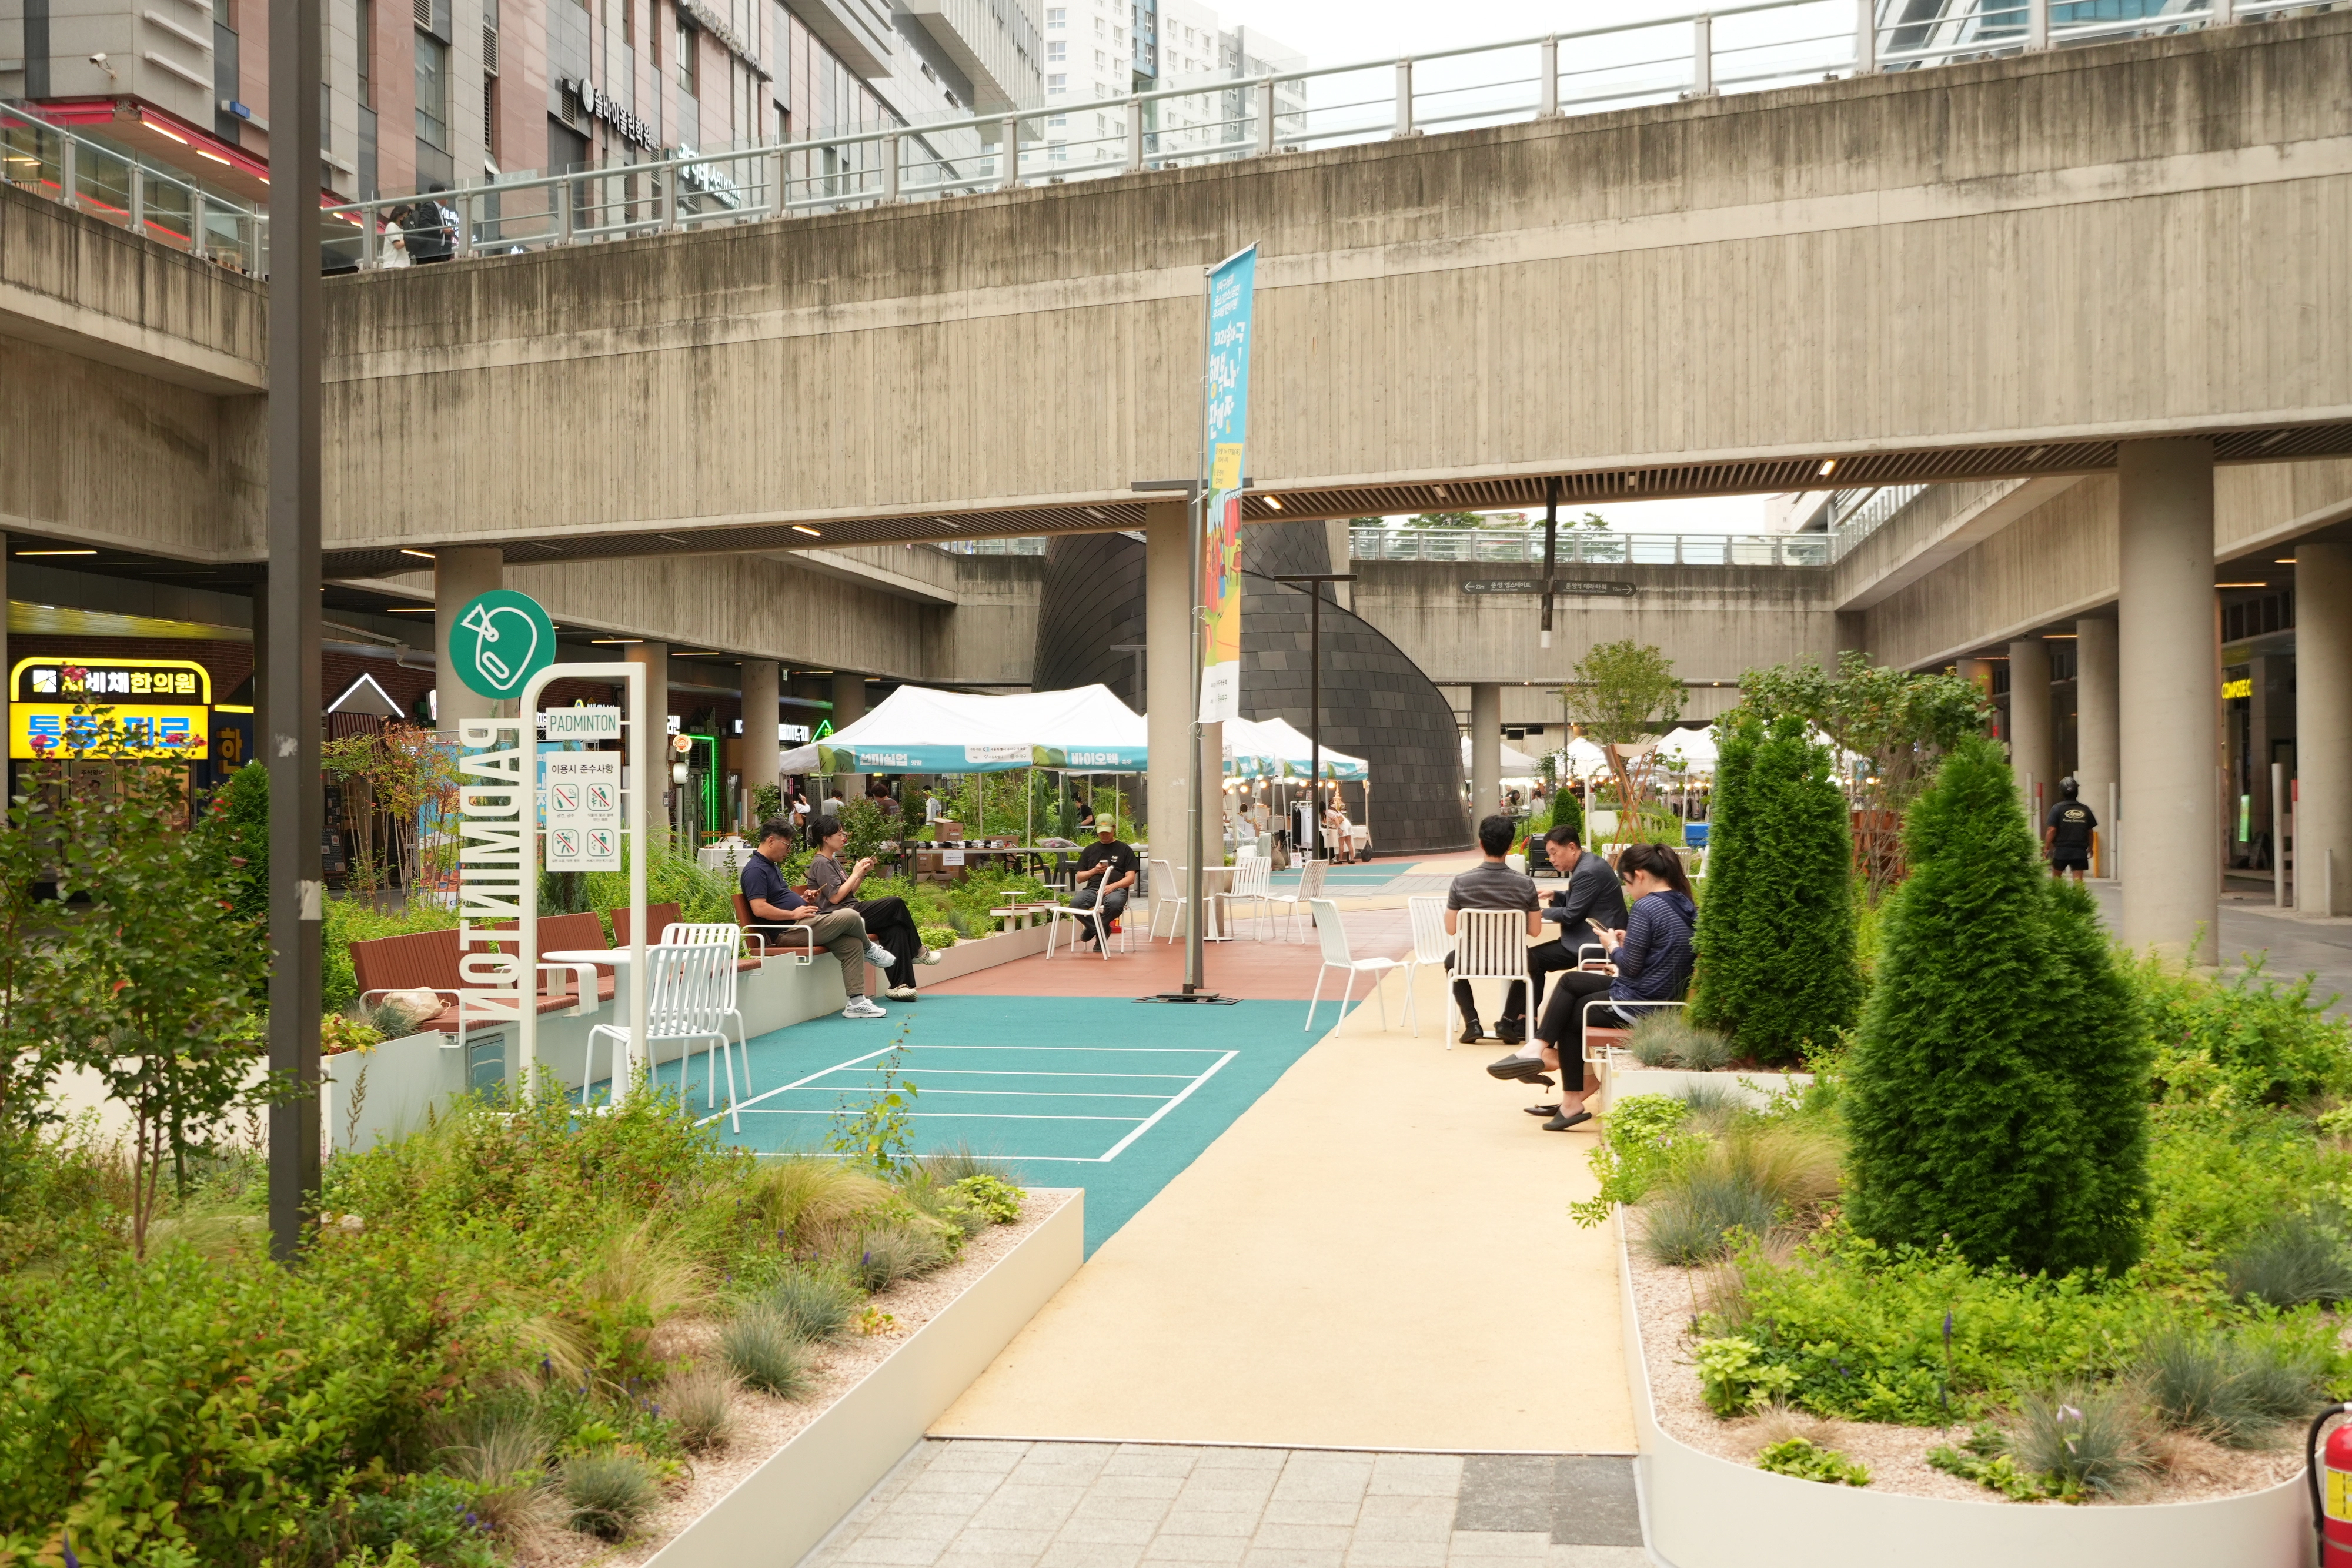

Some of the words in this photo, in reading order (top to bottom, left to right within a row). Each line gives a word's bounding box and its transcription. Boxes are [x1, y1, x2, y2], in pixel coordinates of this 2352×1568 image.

[569, 81, 578, 93] B219
[594, 89, 651, 152] 솔바이올린학원
[716, 171, 723, 187] AT
[2221, 679, 2246, 699] COMPOSE
[550, 714, 616, 731] PADMINTON
[859, 753, 908, 767] 선미실업
[1071, 753, 1119, 765] 바이오텍
[552, 764, 576, 774] 이용시
[580, 764, 613, 774] 준수사항
